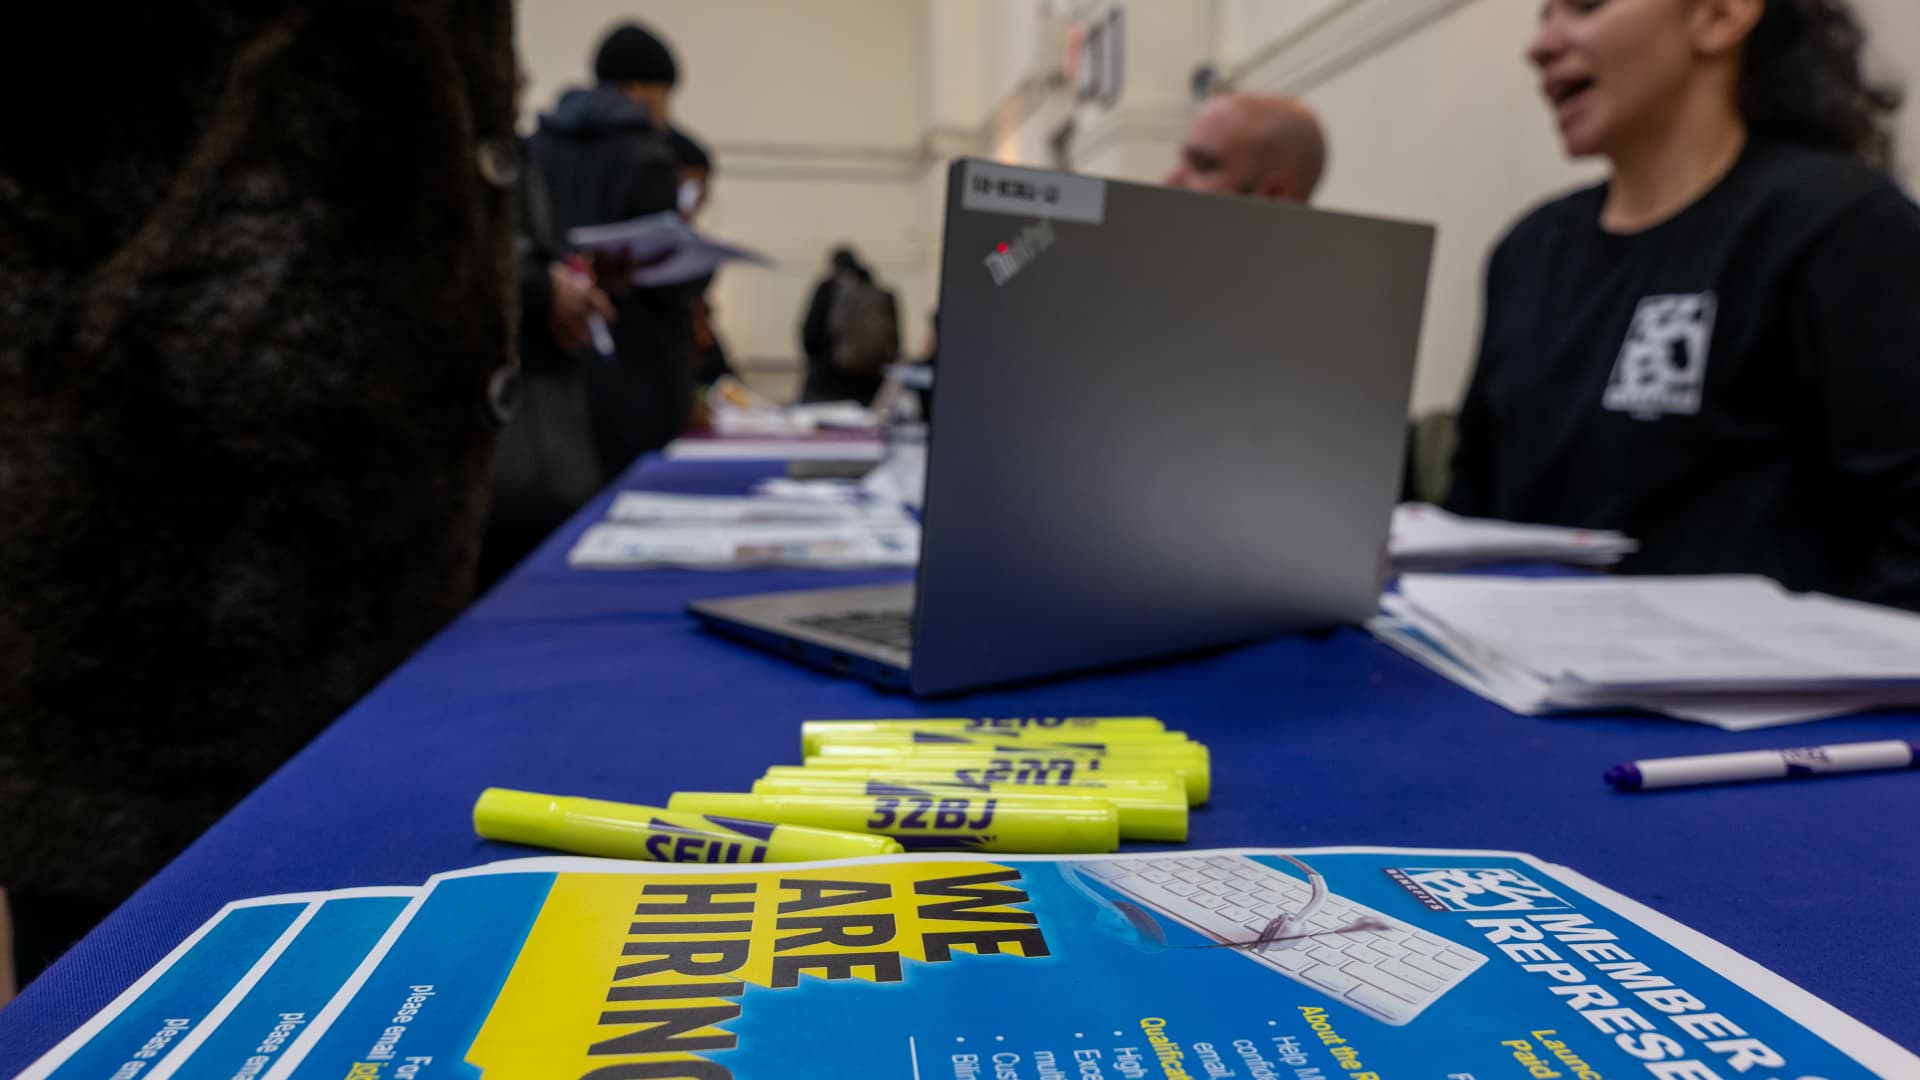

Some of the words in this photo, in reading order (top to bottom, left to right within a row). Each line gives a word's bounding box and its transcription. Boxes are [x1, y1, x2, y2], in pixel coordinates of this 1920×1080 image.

[867, 798, 997, 830] 32BJ
[1384, 868, 1446, 911] BENEFITS
[771, 878, 904, 989] ARE
[913, 869, 1051, 963] WE
[392, 985, 436, 1023] please
[1526, 913, 1786, 1073] MEMBER
[133, 1018, 190, 1058] please
[256, 1012, 306, 1053] please
[366, 1025, 407, 1060] email
[1272, 1036, 1308, 1066] Help
[1297, 1005, 1347, 1046] About
[1329, 1046, 1363, 1070] the
[1113, 1047, 1149, 1079] High
[1501, 1040, 1562, 1079] Paid
